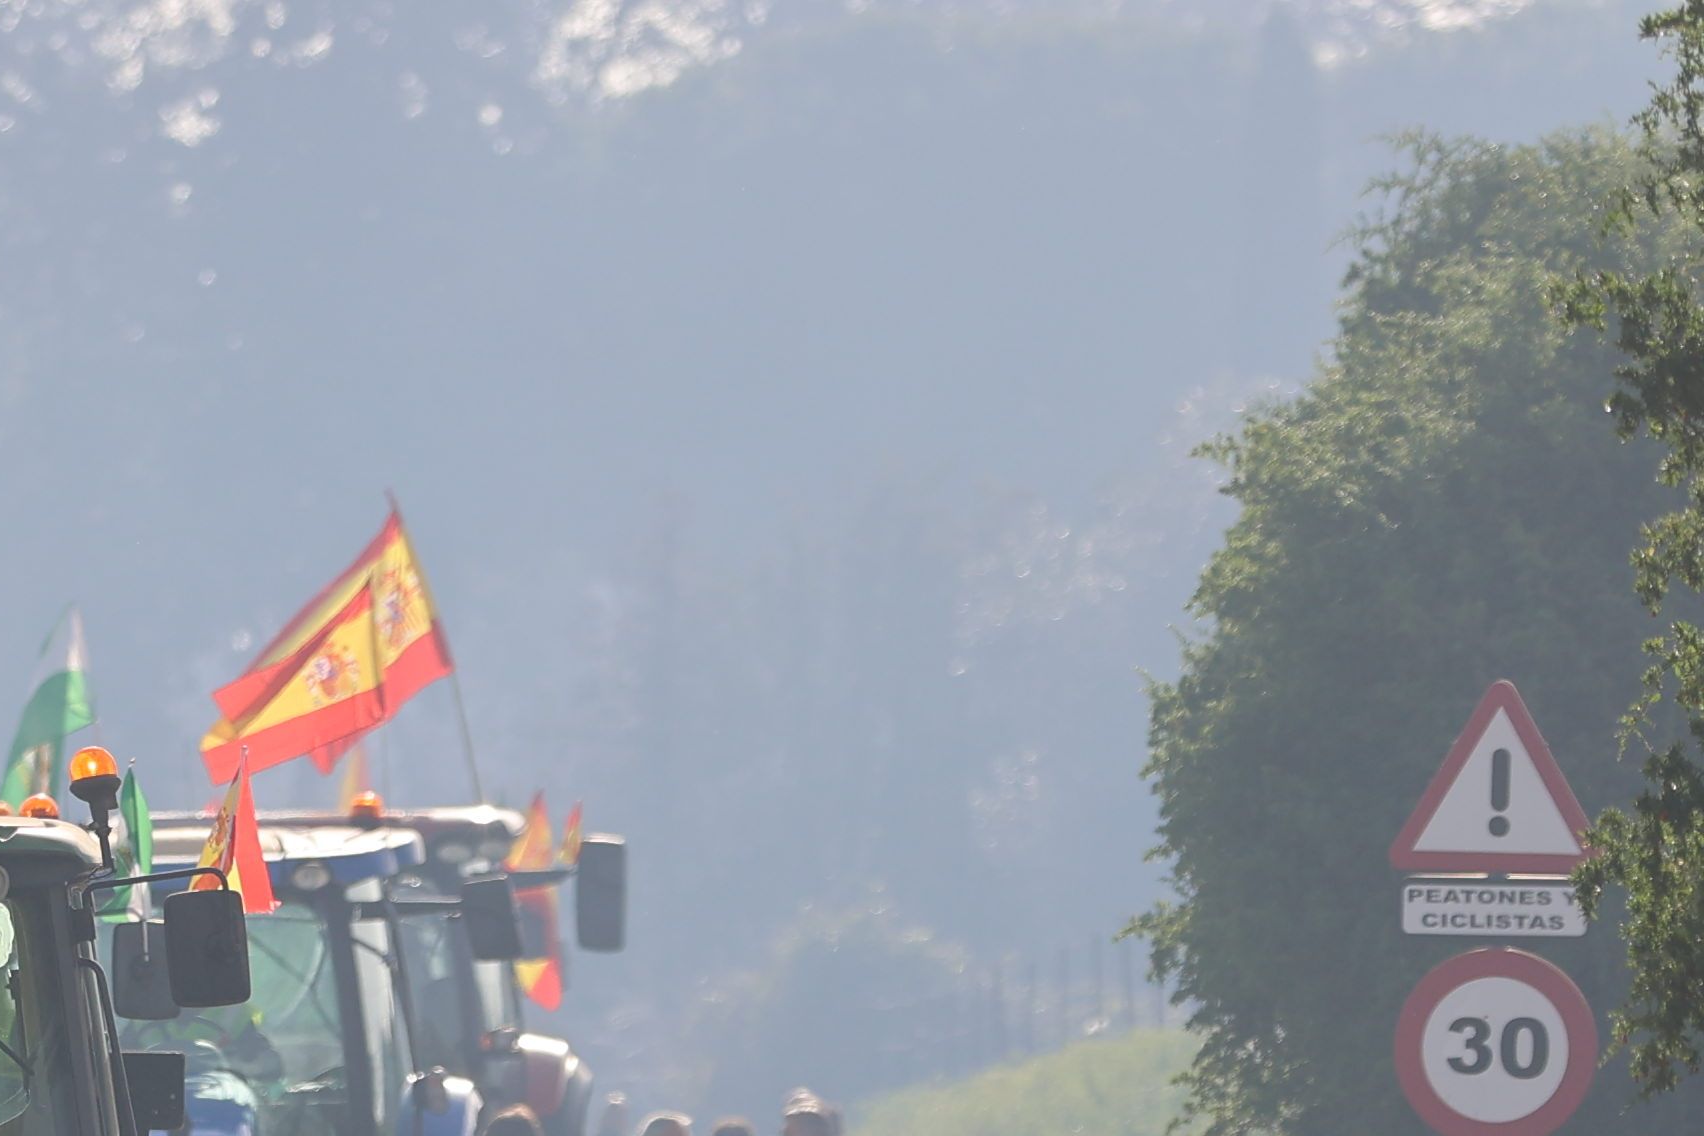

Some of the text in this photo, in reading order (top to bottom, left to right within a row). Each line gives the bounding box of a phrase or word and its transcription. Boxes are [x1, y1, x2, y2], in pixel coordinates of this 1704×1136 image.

[1407, 888, 1578, 906] PEATONES Y
[1421, 912, 1566, 931] CICLISTAS
[1446, 1015, 1551, 1080] 30
